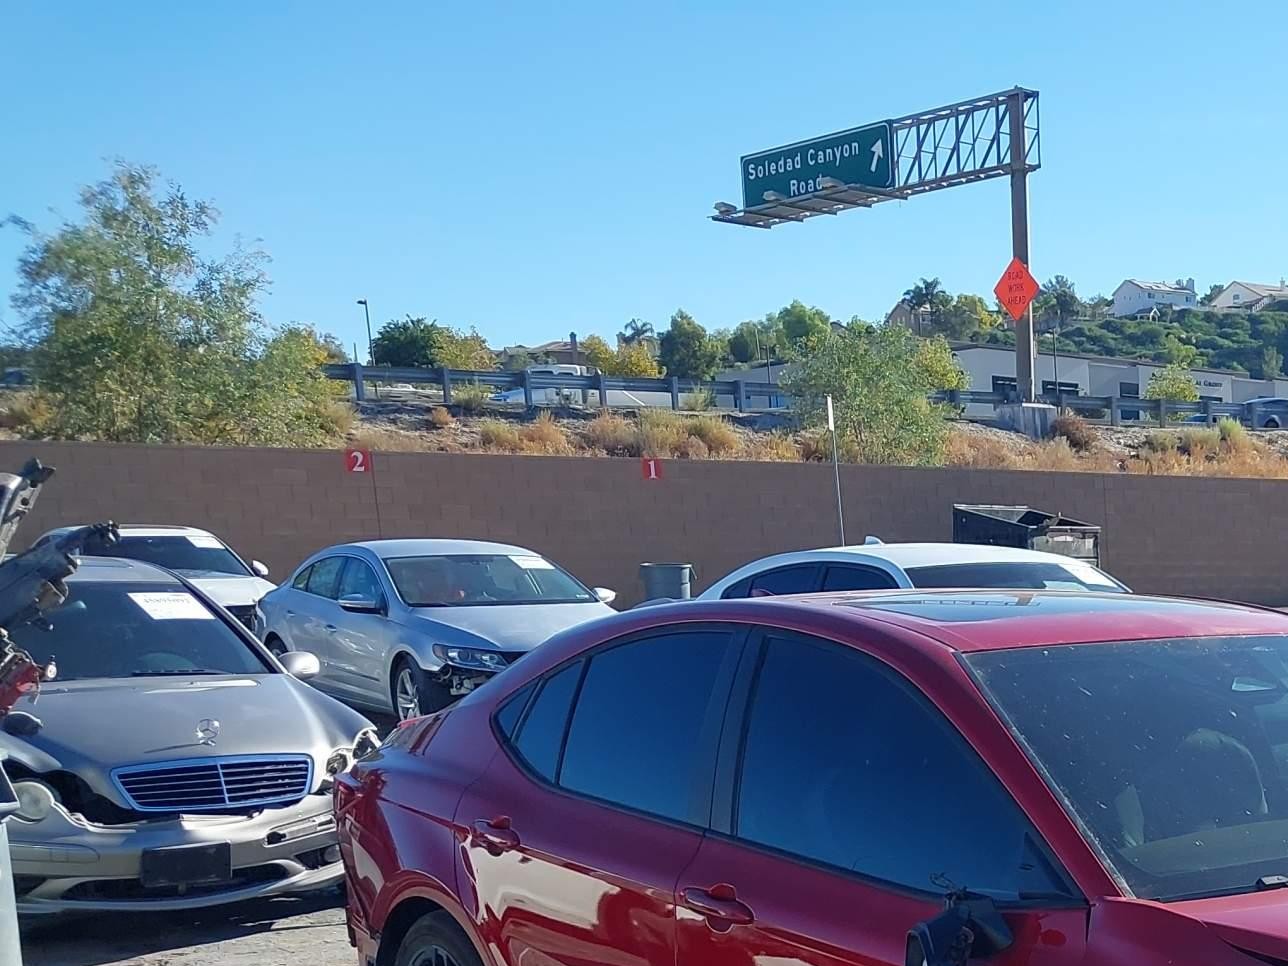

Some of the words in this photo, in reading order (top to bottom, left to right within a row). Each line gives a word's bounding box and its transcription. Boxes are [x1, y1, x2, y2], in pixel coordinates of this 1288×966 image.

[748, 152, 801, 180] Soledad
[807, 142, 859, 167] Canyon
[790, 173, 822, 197] Road
[1007, 295, 1026, 305] AHEAD
[351, 451, 365, 472] 2
[648, 460, 657, 479] 1
